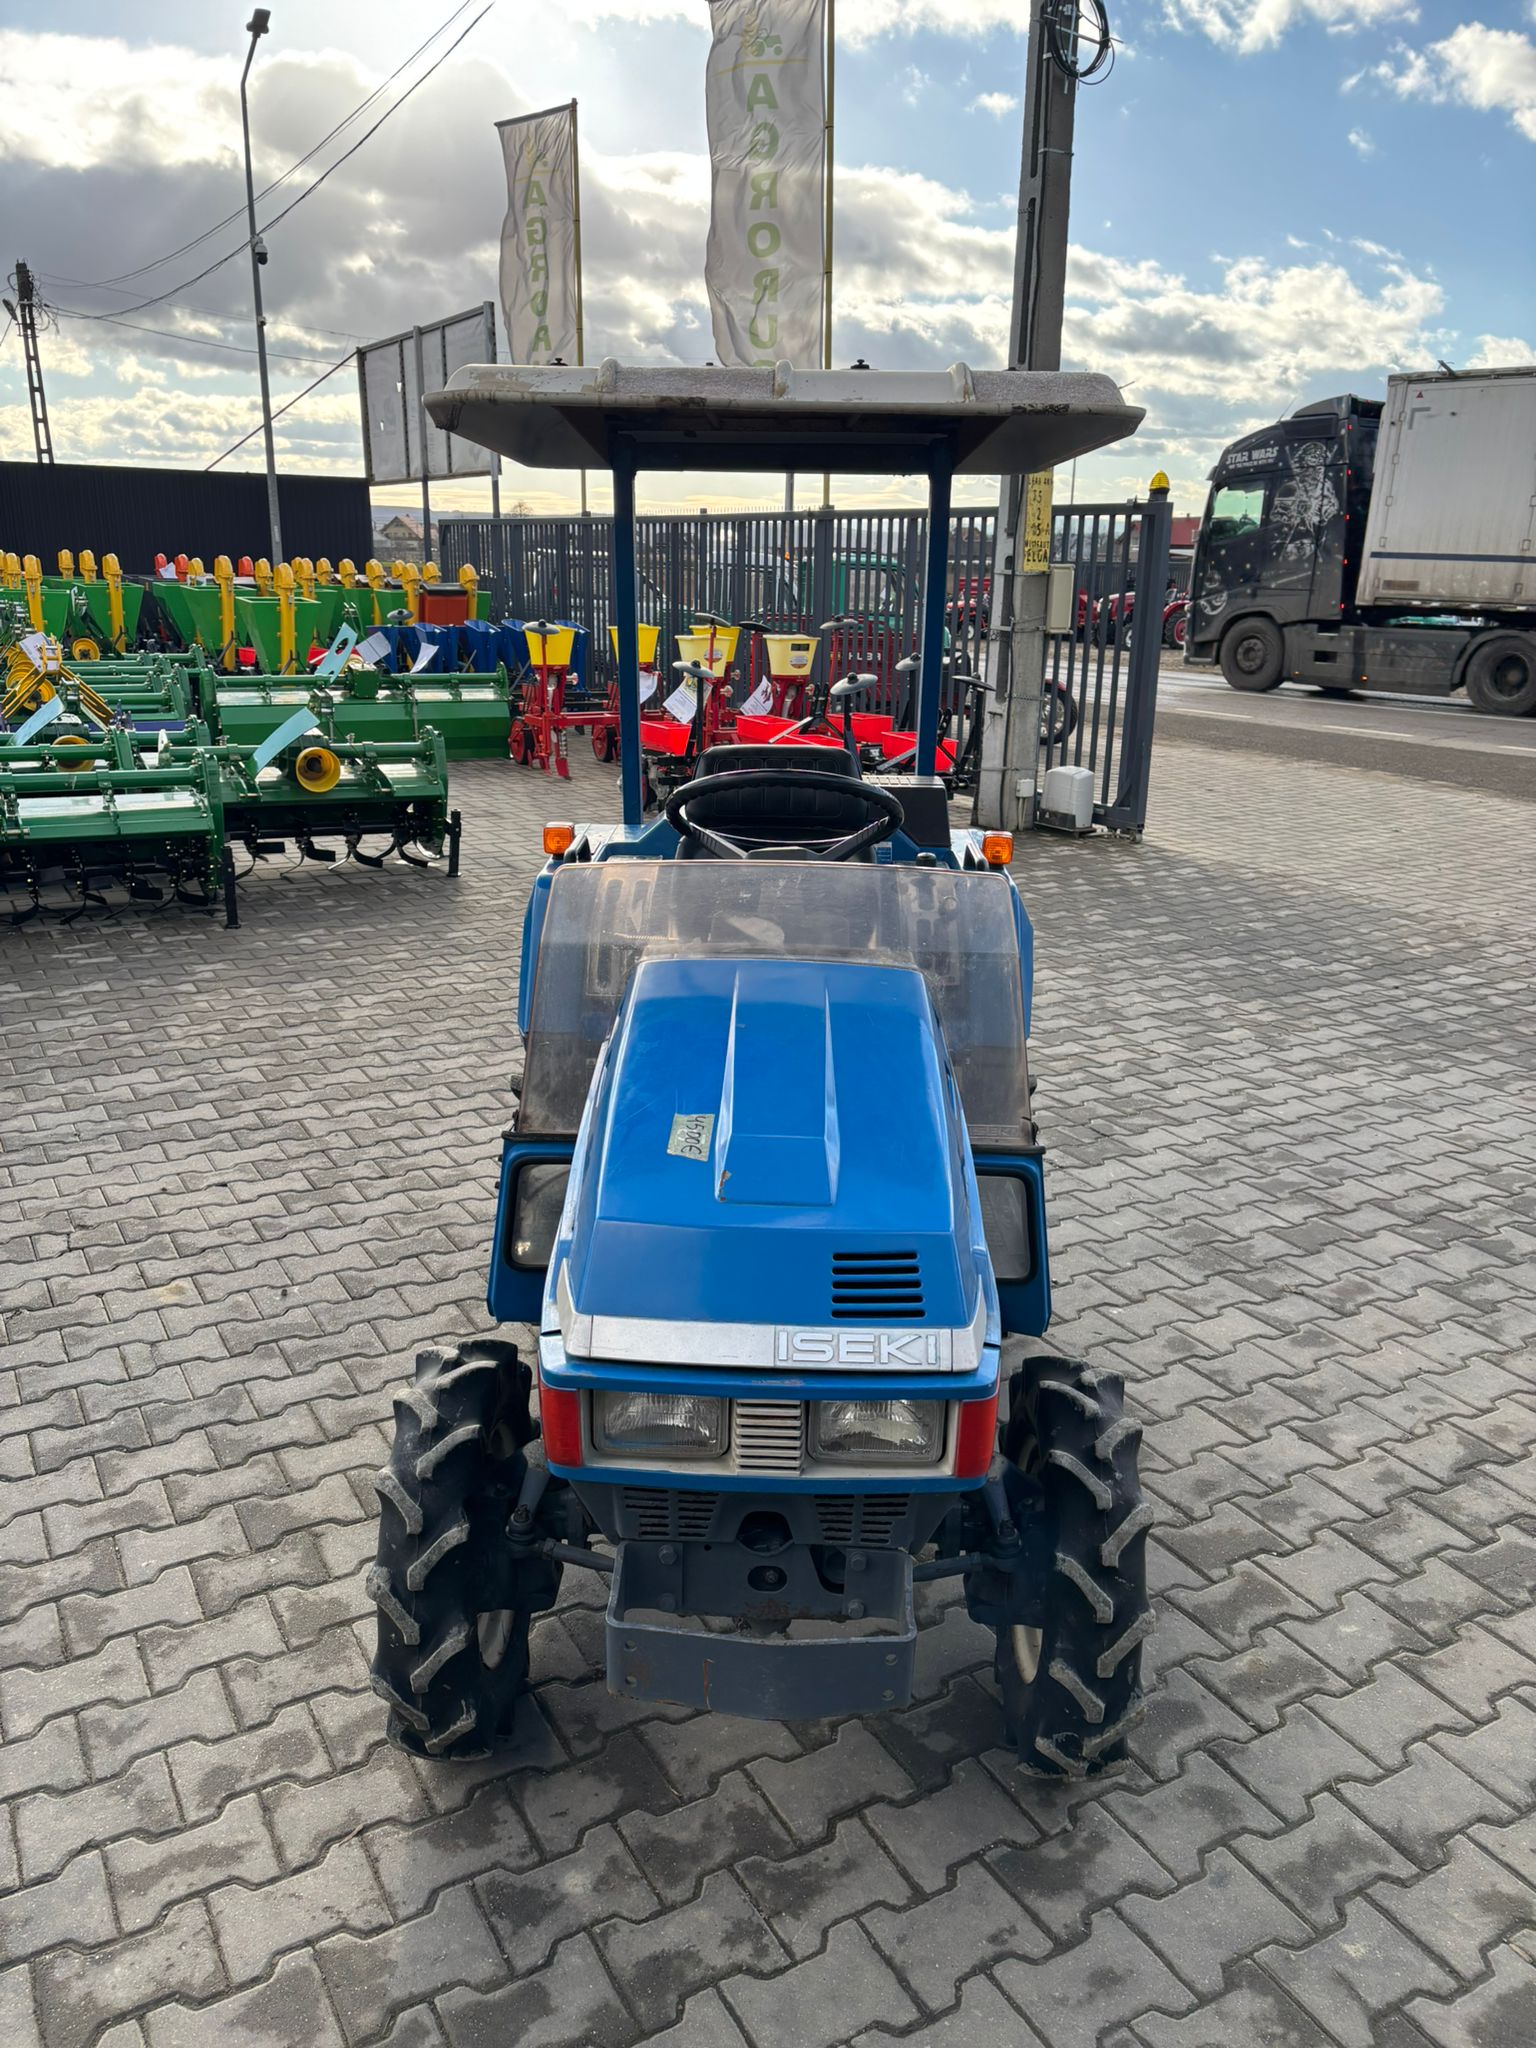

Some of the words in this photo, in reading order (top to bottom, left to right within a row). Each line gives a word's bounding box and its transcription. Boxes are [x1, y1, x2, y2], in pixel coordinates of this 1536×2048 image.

[1226, 451, 1249, 465] STAR
[1252, 446, 1279, 460] WARS
[778, 1330, 938, 1365] ISEKI
